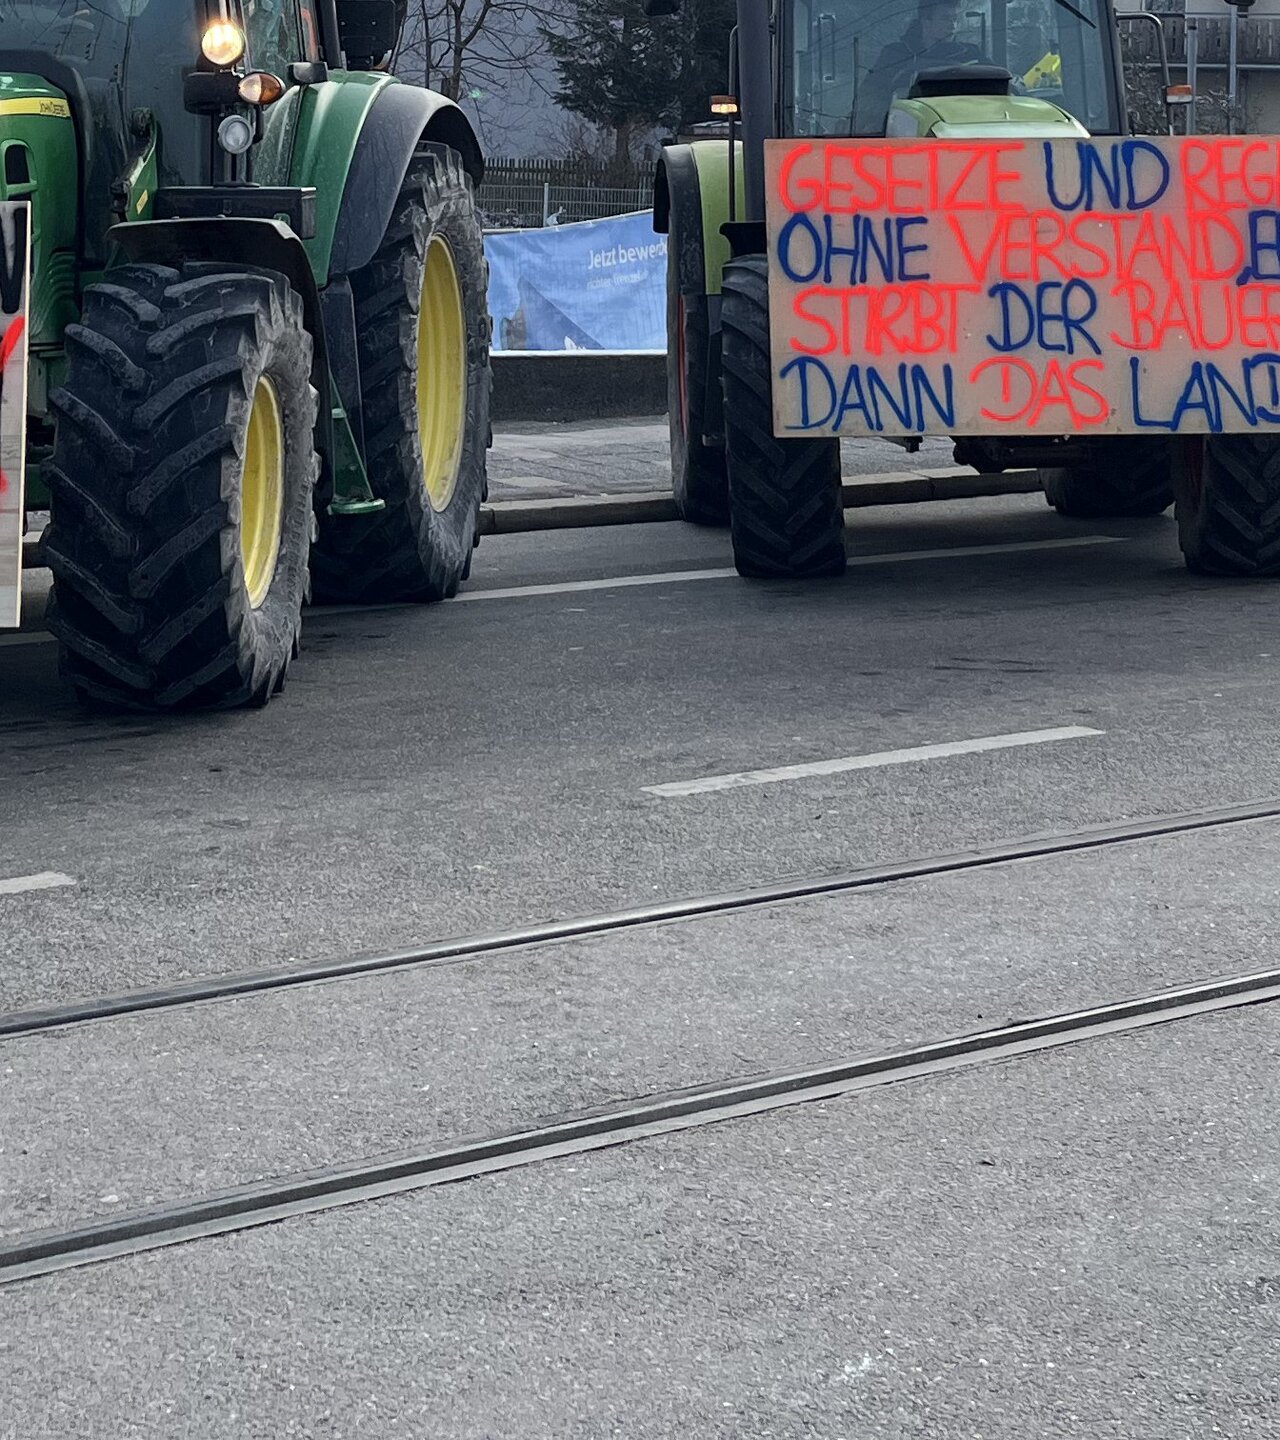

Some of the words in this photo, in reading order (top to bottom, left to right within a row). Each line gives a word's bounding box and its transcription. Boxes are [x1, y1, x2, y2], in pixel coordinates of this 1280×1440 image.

[779, 141, 1027, 213] GESETZE
[1043, 140, 1170, 211] UND
[587, 249, 616, 270] Jetzt
[778, 212, 930, 285] OHNE
[789, 280, 982, 356] STIRBT
[986, 278, 1101, 355] DER
[780, 356, 955, 432] DANN
[970, 356, 1110, 430] DAS
